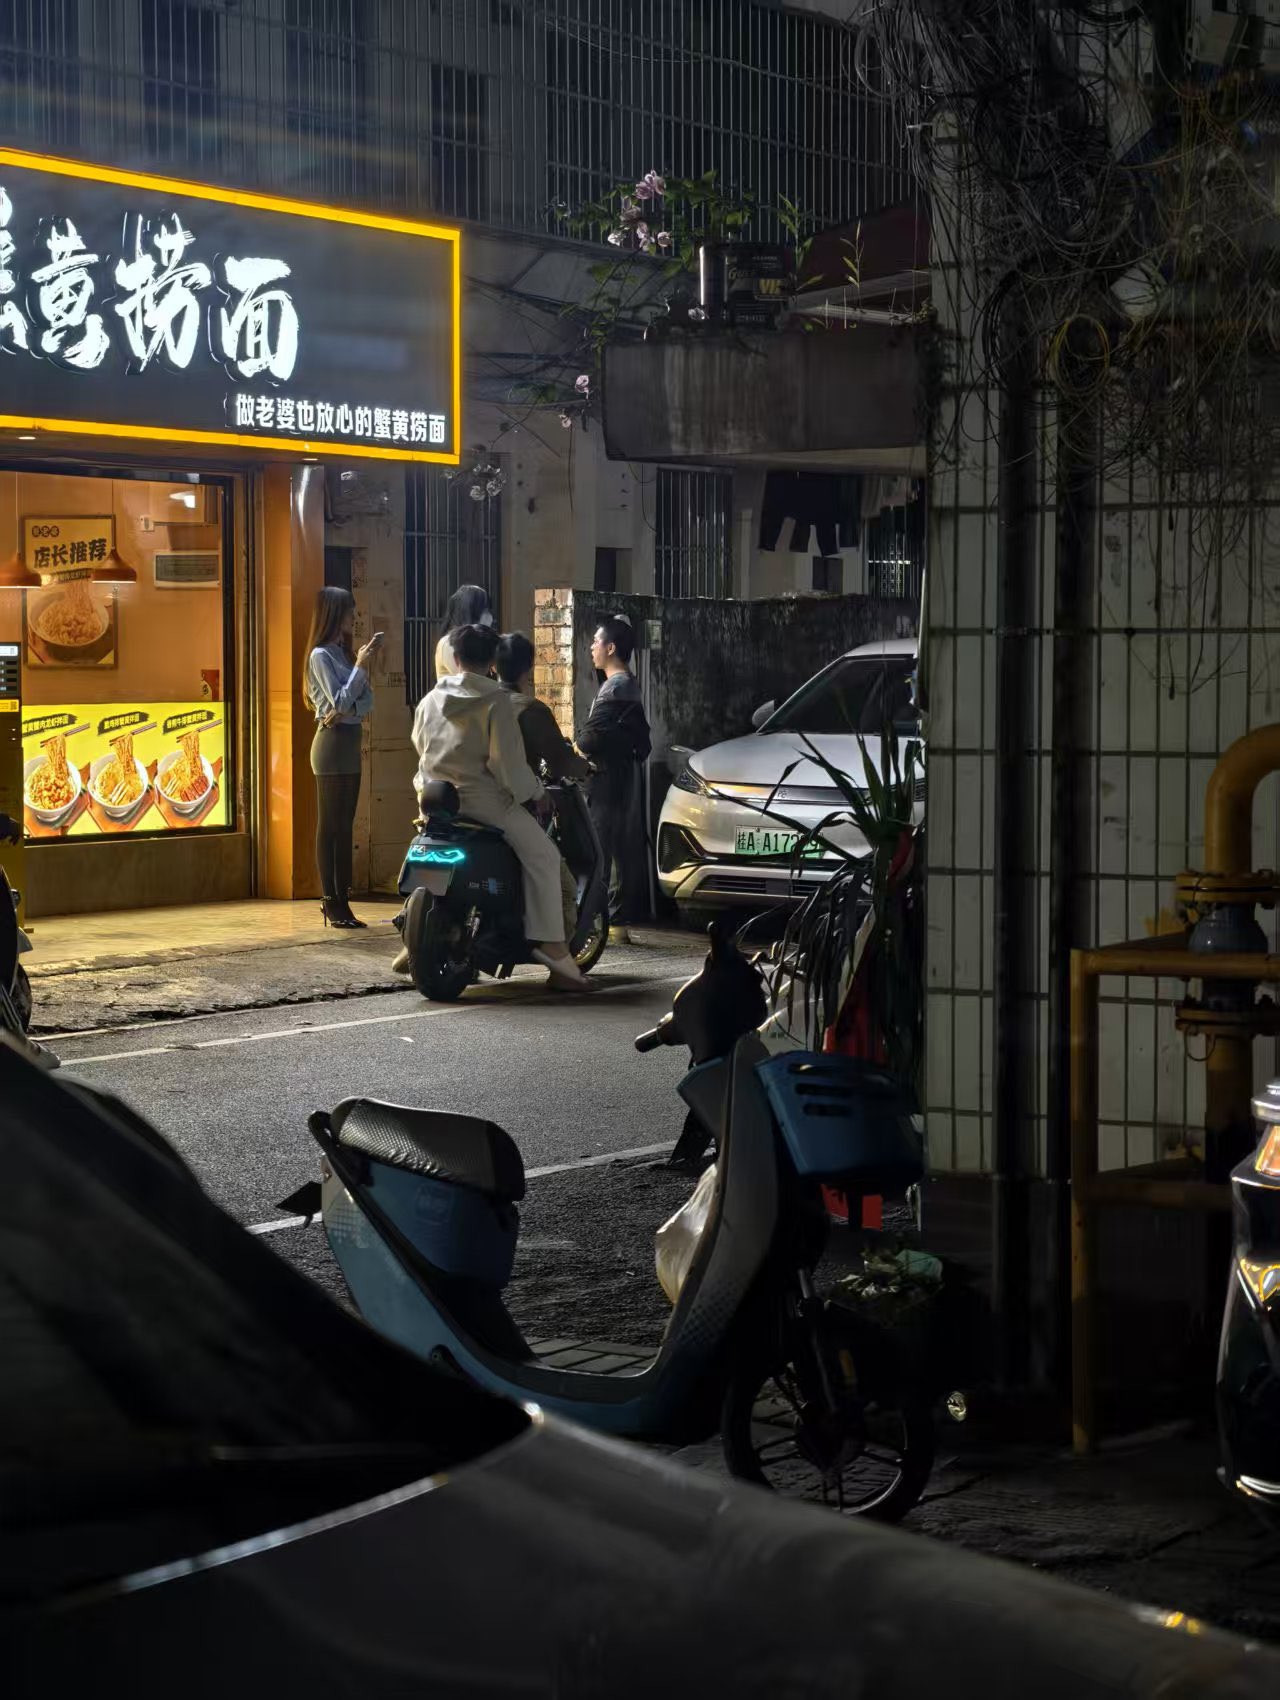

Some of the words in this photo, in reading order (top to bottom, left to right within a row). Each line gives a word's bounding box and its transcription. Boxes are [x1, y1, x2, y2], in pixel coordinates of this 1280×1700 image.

[236, 393, 446, 443] 做老婆也放心的蟹黄捞面
[34, 538, 107, 568] 店长推荐
[763, 833, 818, 853] A1729
